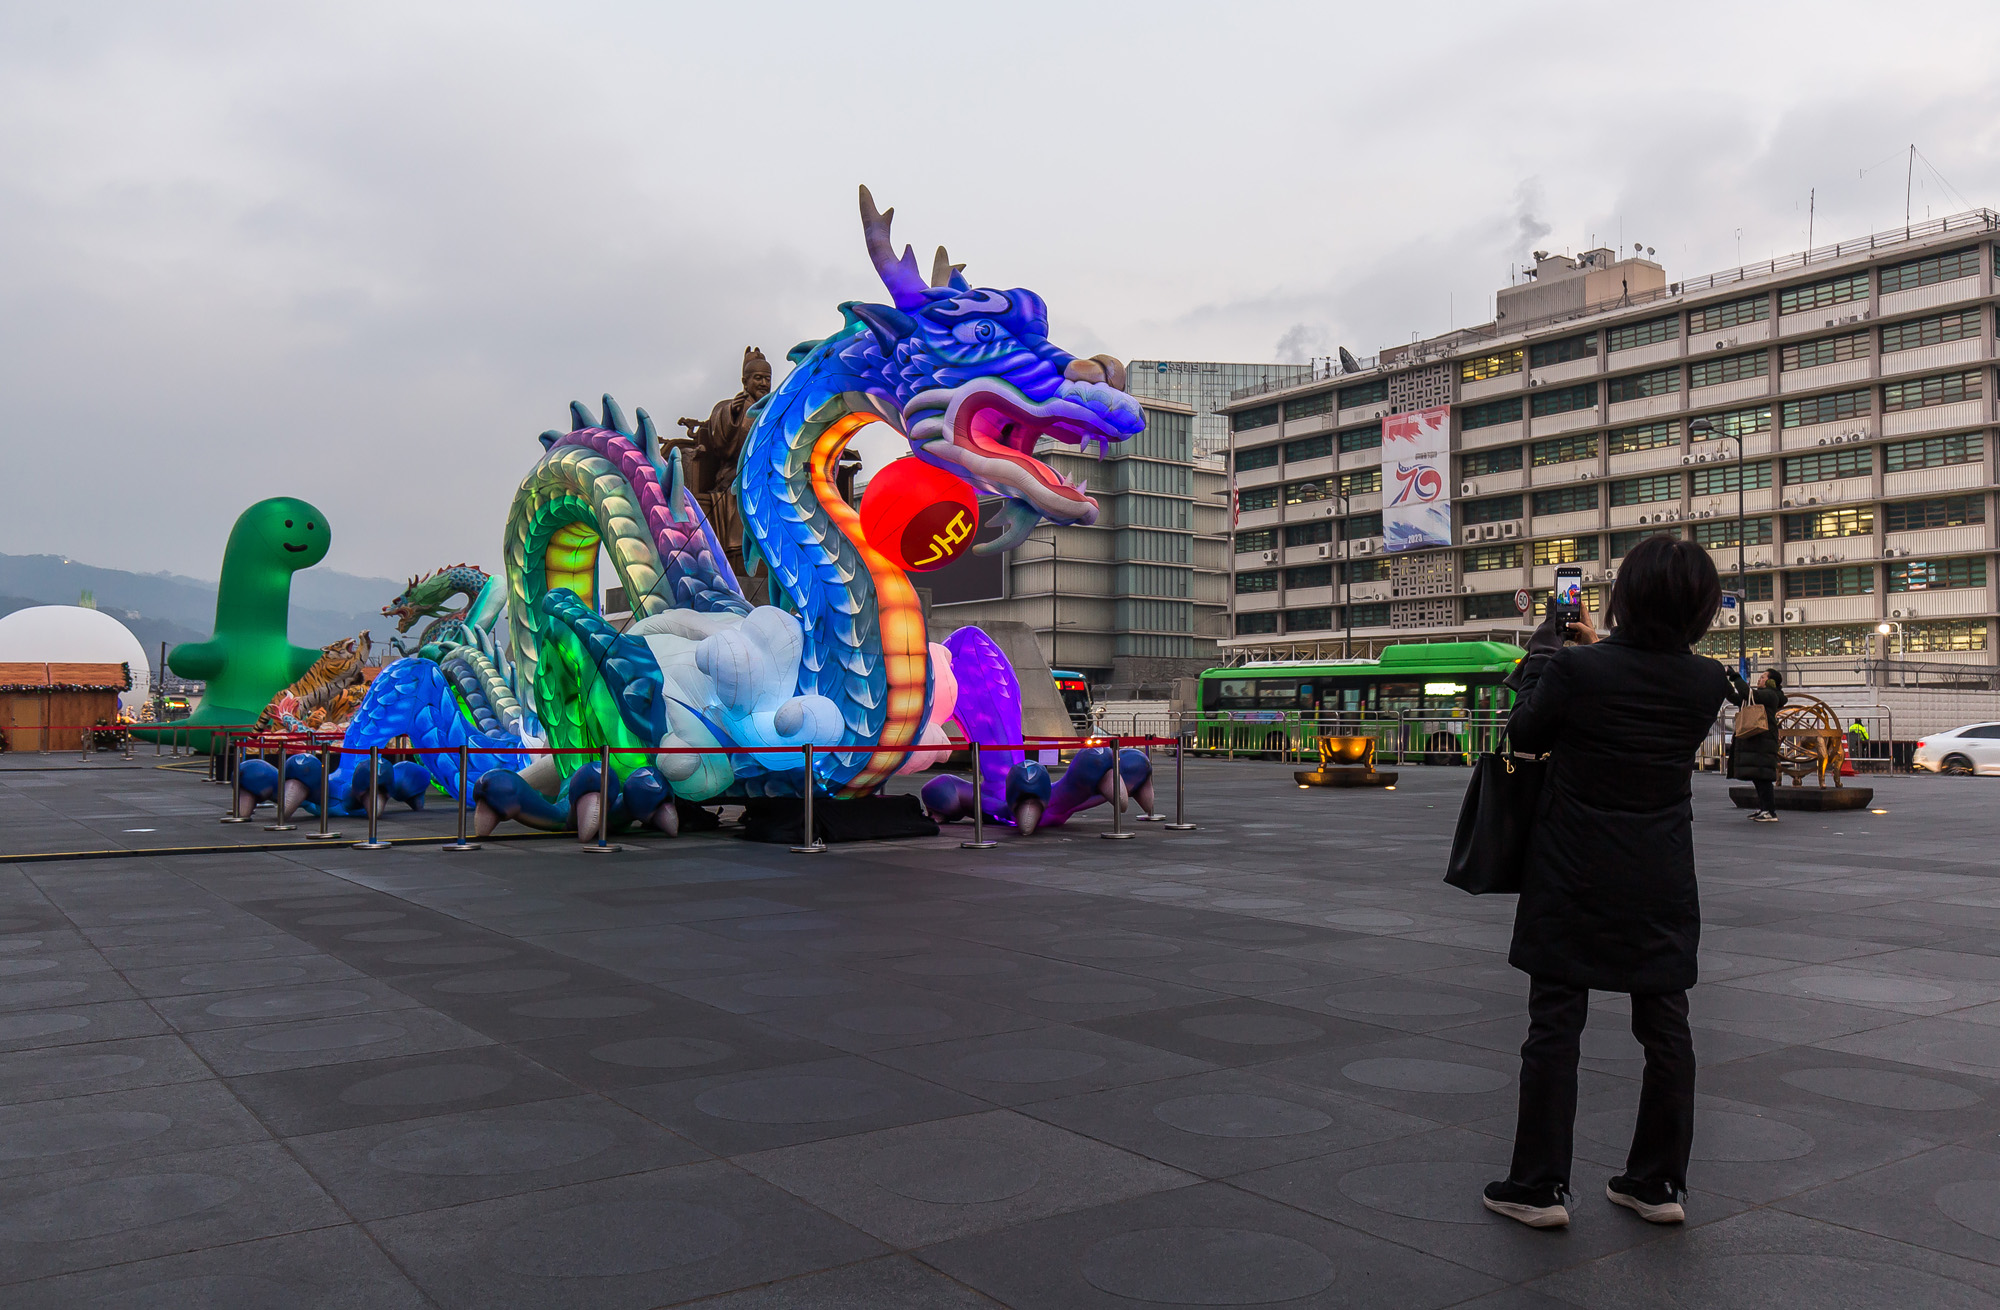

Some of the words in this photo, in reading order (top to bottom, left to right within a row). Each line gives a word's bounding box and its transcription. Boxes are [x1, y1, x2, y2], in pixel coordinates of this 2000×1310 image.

[1390, 462, 1442, 507] 70
[914, 510, 973, 566] 복
[1519, 595, 1528, 606] 50
